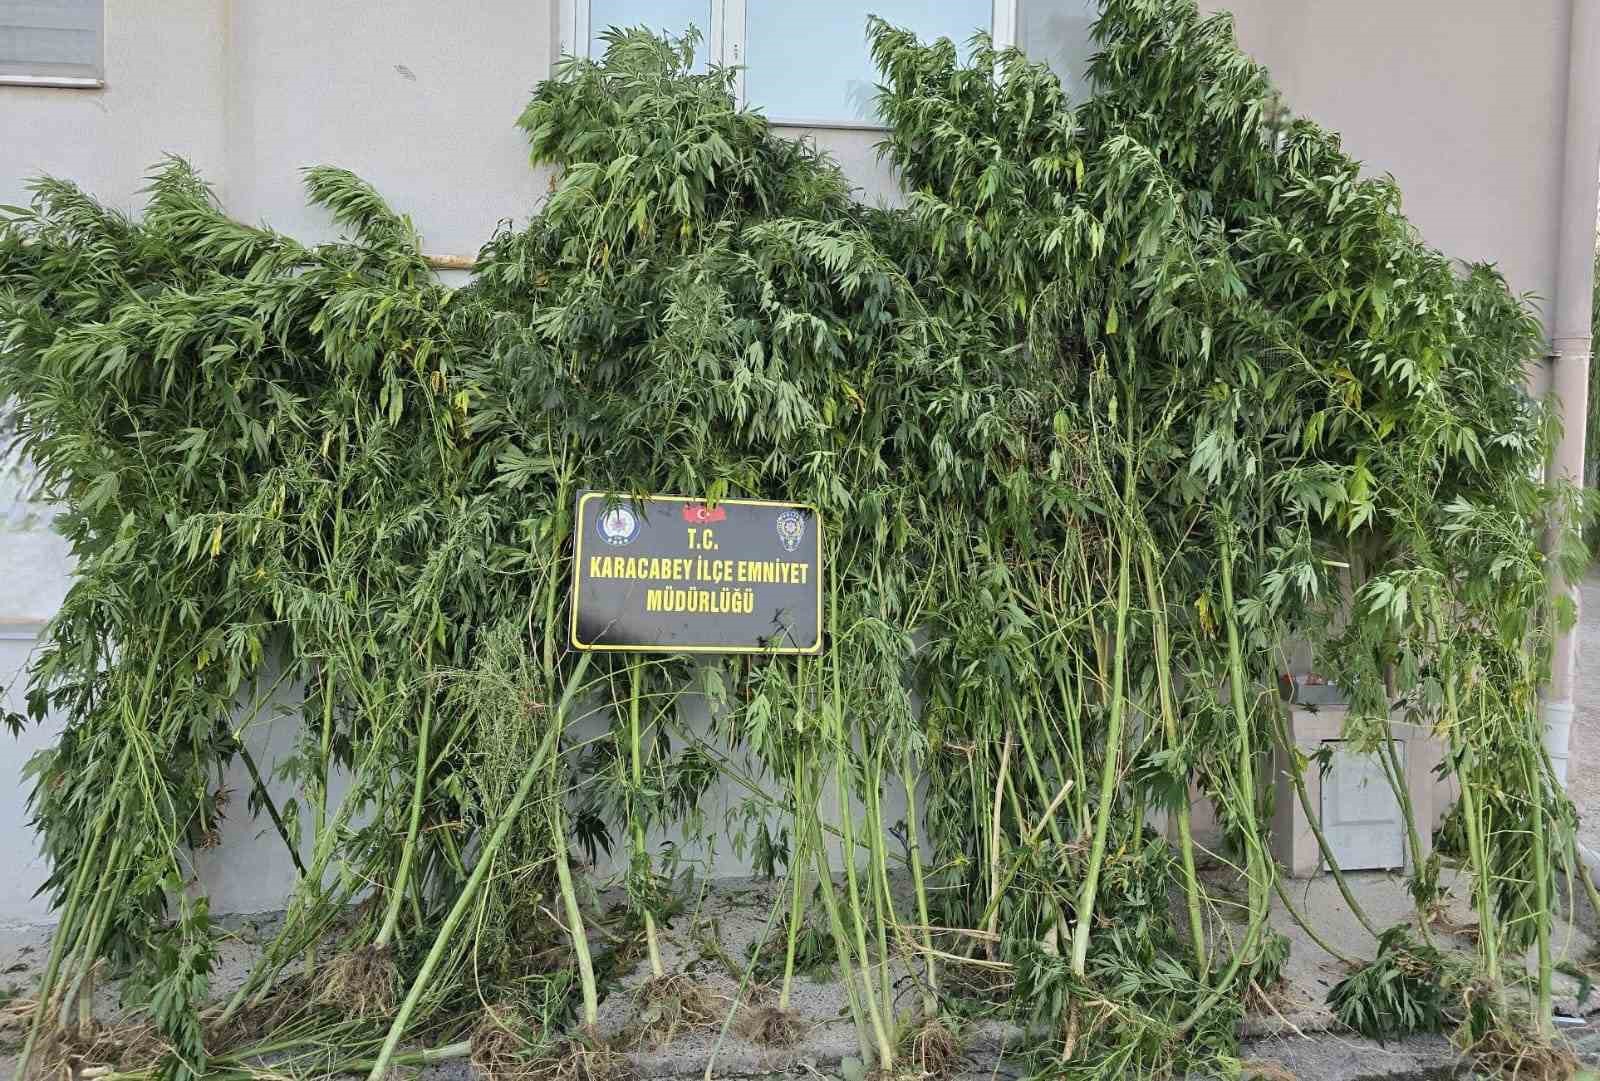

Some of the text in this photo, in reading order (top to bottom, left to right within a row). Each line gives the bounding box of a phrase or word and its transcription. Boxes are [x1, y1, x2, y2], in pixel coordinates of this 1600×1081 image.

[590, 555, 809, 584] KARACABEY İLÇE EMNİYET
[646, 586, 755, 614] MÜDÜRLÜĞÜ
